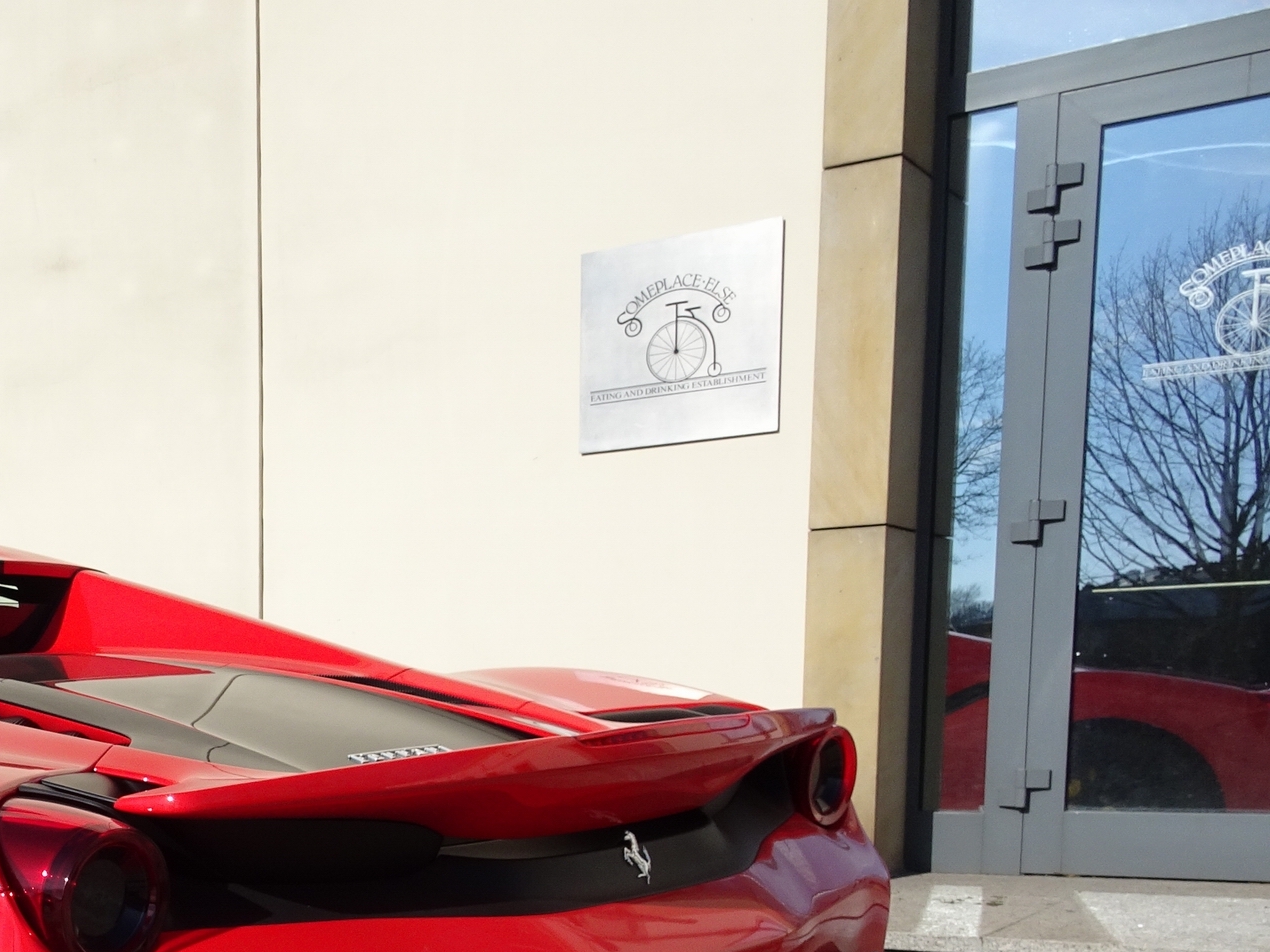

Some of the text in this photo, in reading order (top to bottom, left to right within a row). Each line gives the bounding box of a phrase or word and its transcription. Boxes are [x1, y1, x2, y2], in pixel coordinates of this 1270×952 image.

[590, 372, 766, 403] EATING AND DRINKING ESTABLISHMENT
